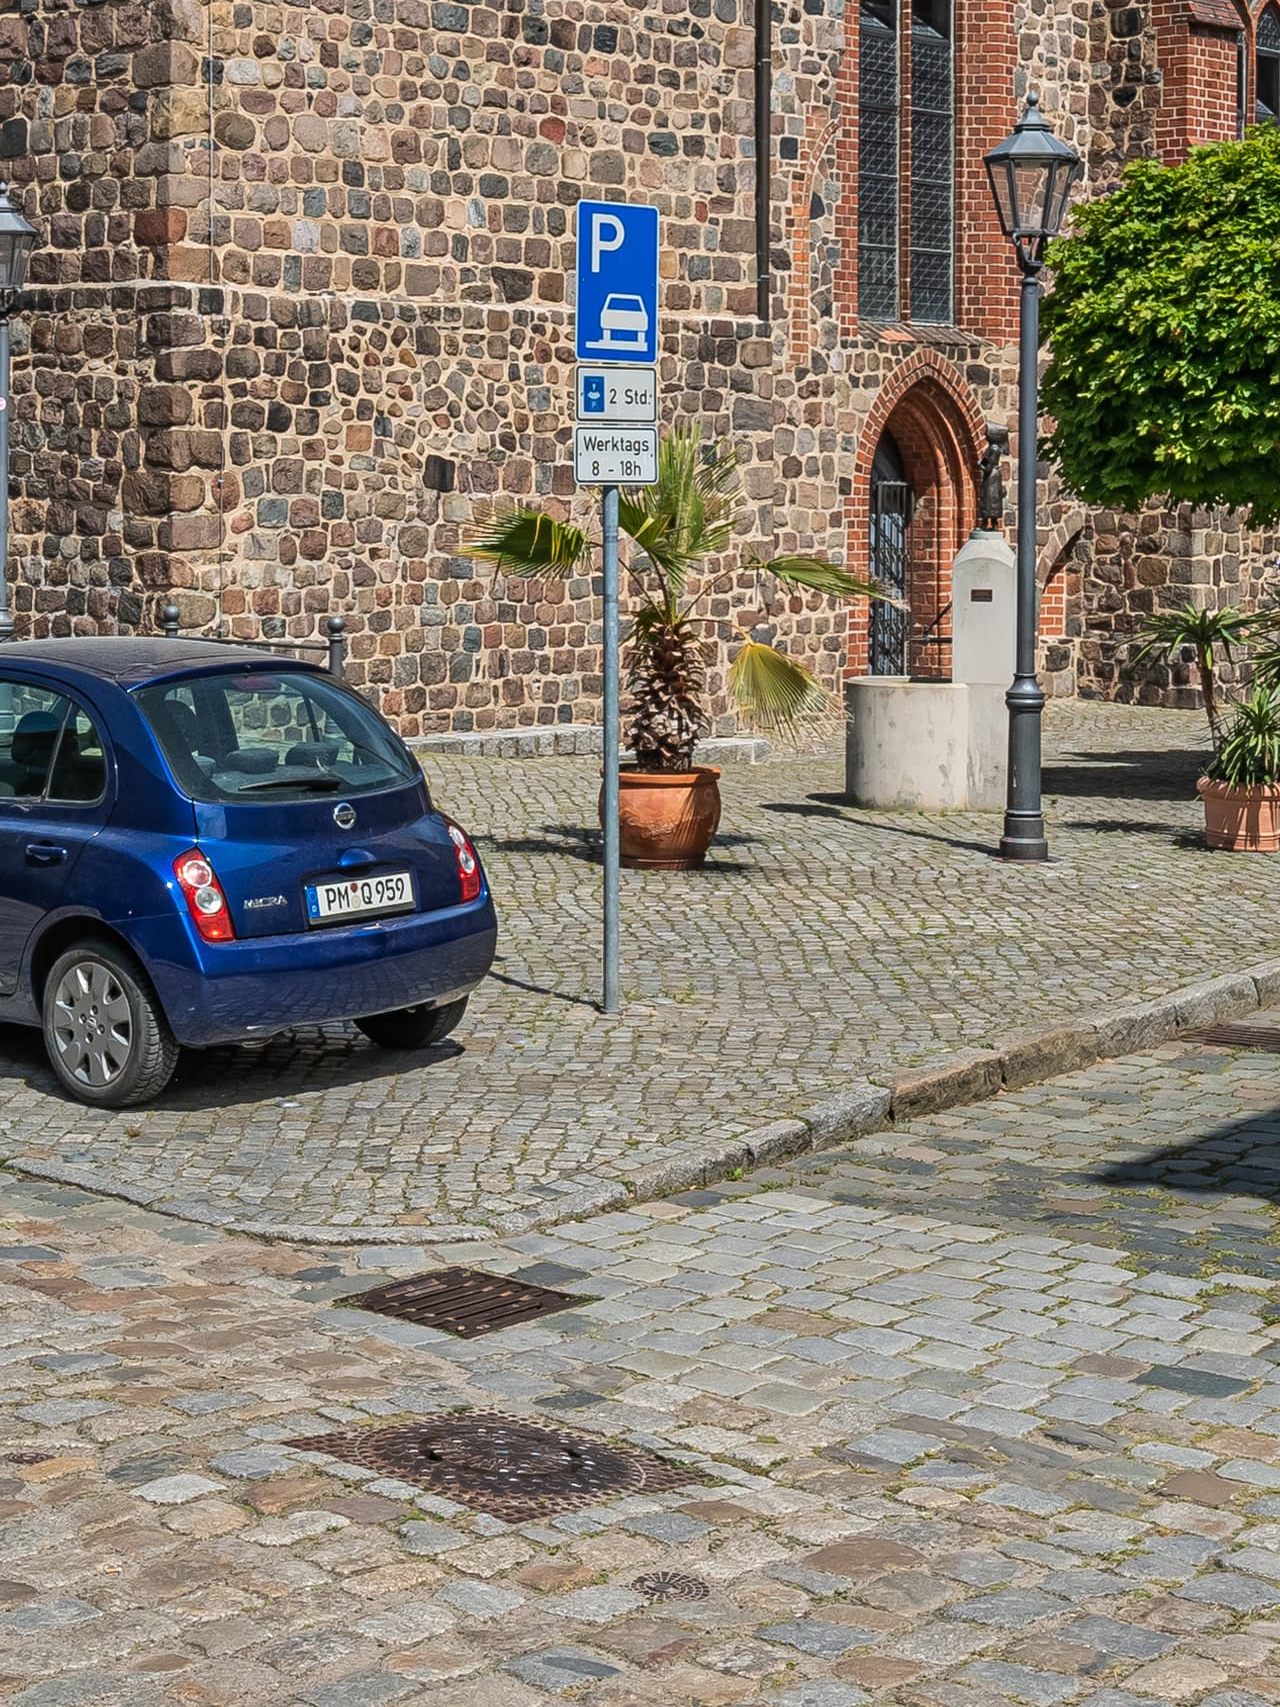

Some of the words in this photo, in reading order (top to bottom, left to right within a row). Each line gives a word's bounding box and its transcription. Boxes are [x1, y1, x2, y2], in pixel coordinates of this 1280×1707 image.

[591, 214, 625, 273] P
[609, 389, 617, 404] 2
[583, 435, 650, 455] Werktags
[592, 460, 600, 476] 8
[620, 461, 642, 476] 18h
[243, 895, 288, 909] MICRA
[325, 885, 350, 911] PM
[361, 882, 373, 904] Q
[375, 877, 405, 903] 959
